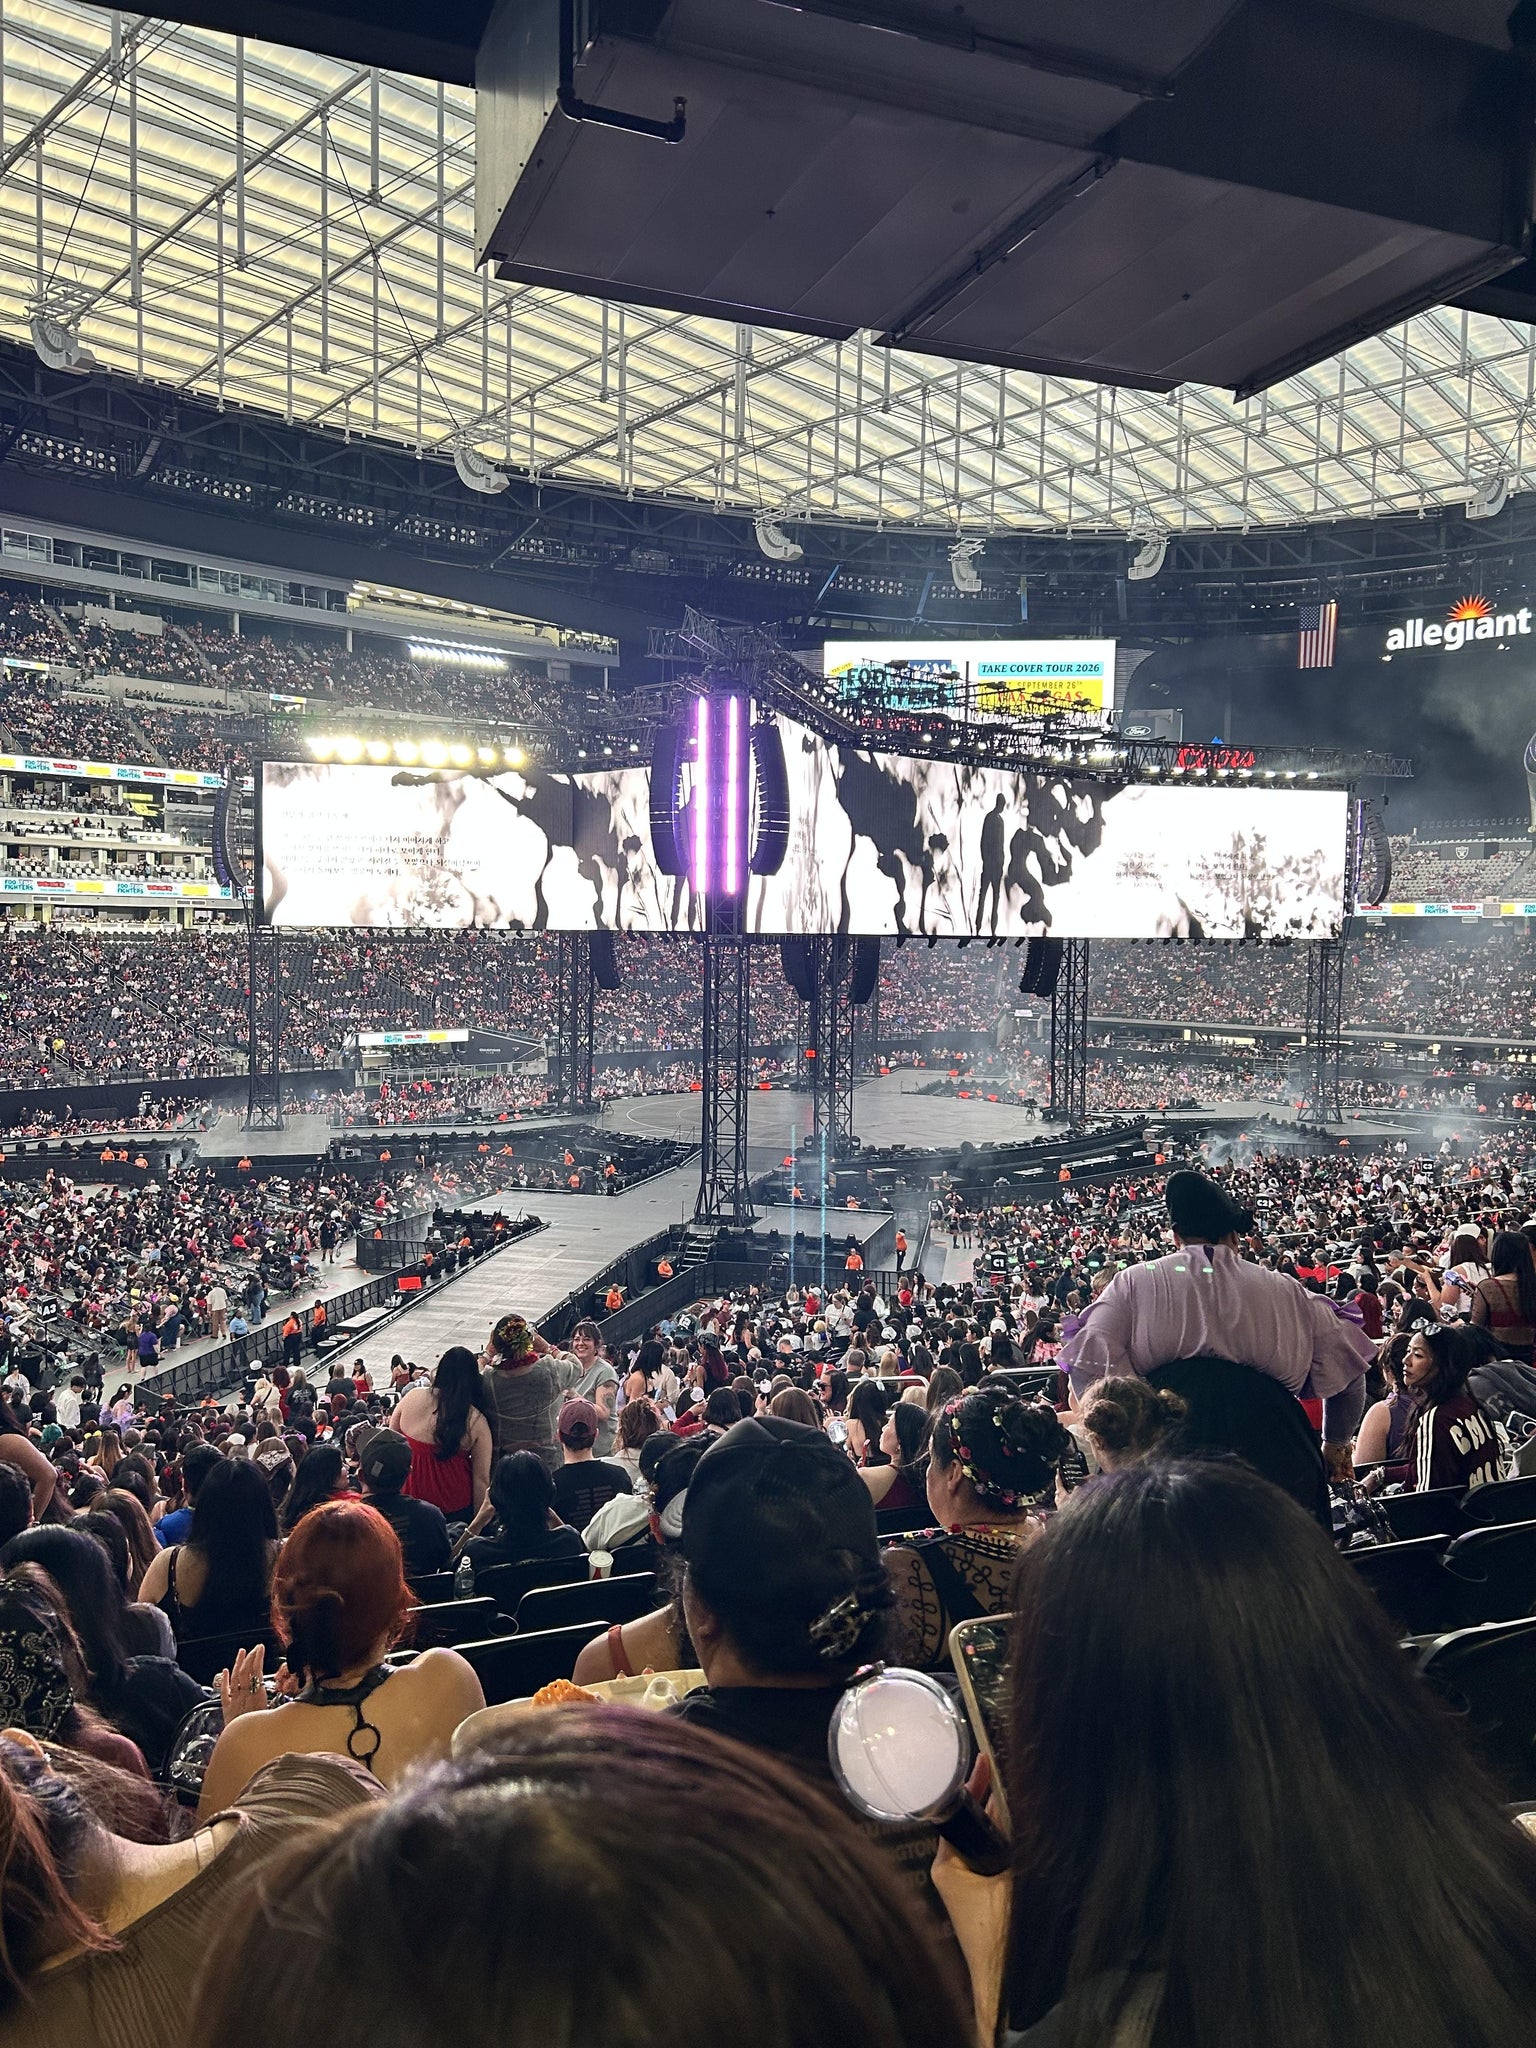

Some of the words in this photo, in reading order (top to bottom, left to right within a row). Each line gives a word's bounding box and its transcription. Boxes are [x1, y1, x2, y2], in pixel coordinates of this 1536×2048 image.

[1386, 608, 1532, 651] allegiant
[982, 664, 1007, 673] TAKE
[1010, 664, 1043, 673] COVER
[1046, 663, 1073, 673] TOUR
[1075, 663, 1100, 672] 2026
[1256, 1199, 1268, 1207] C2
[992, 1259, 1005, 1268] C1
[43, 1303, 57, 1316] A3
